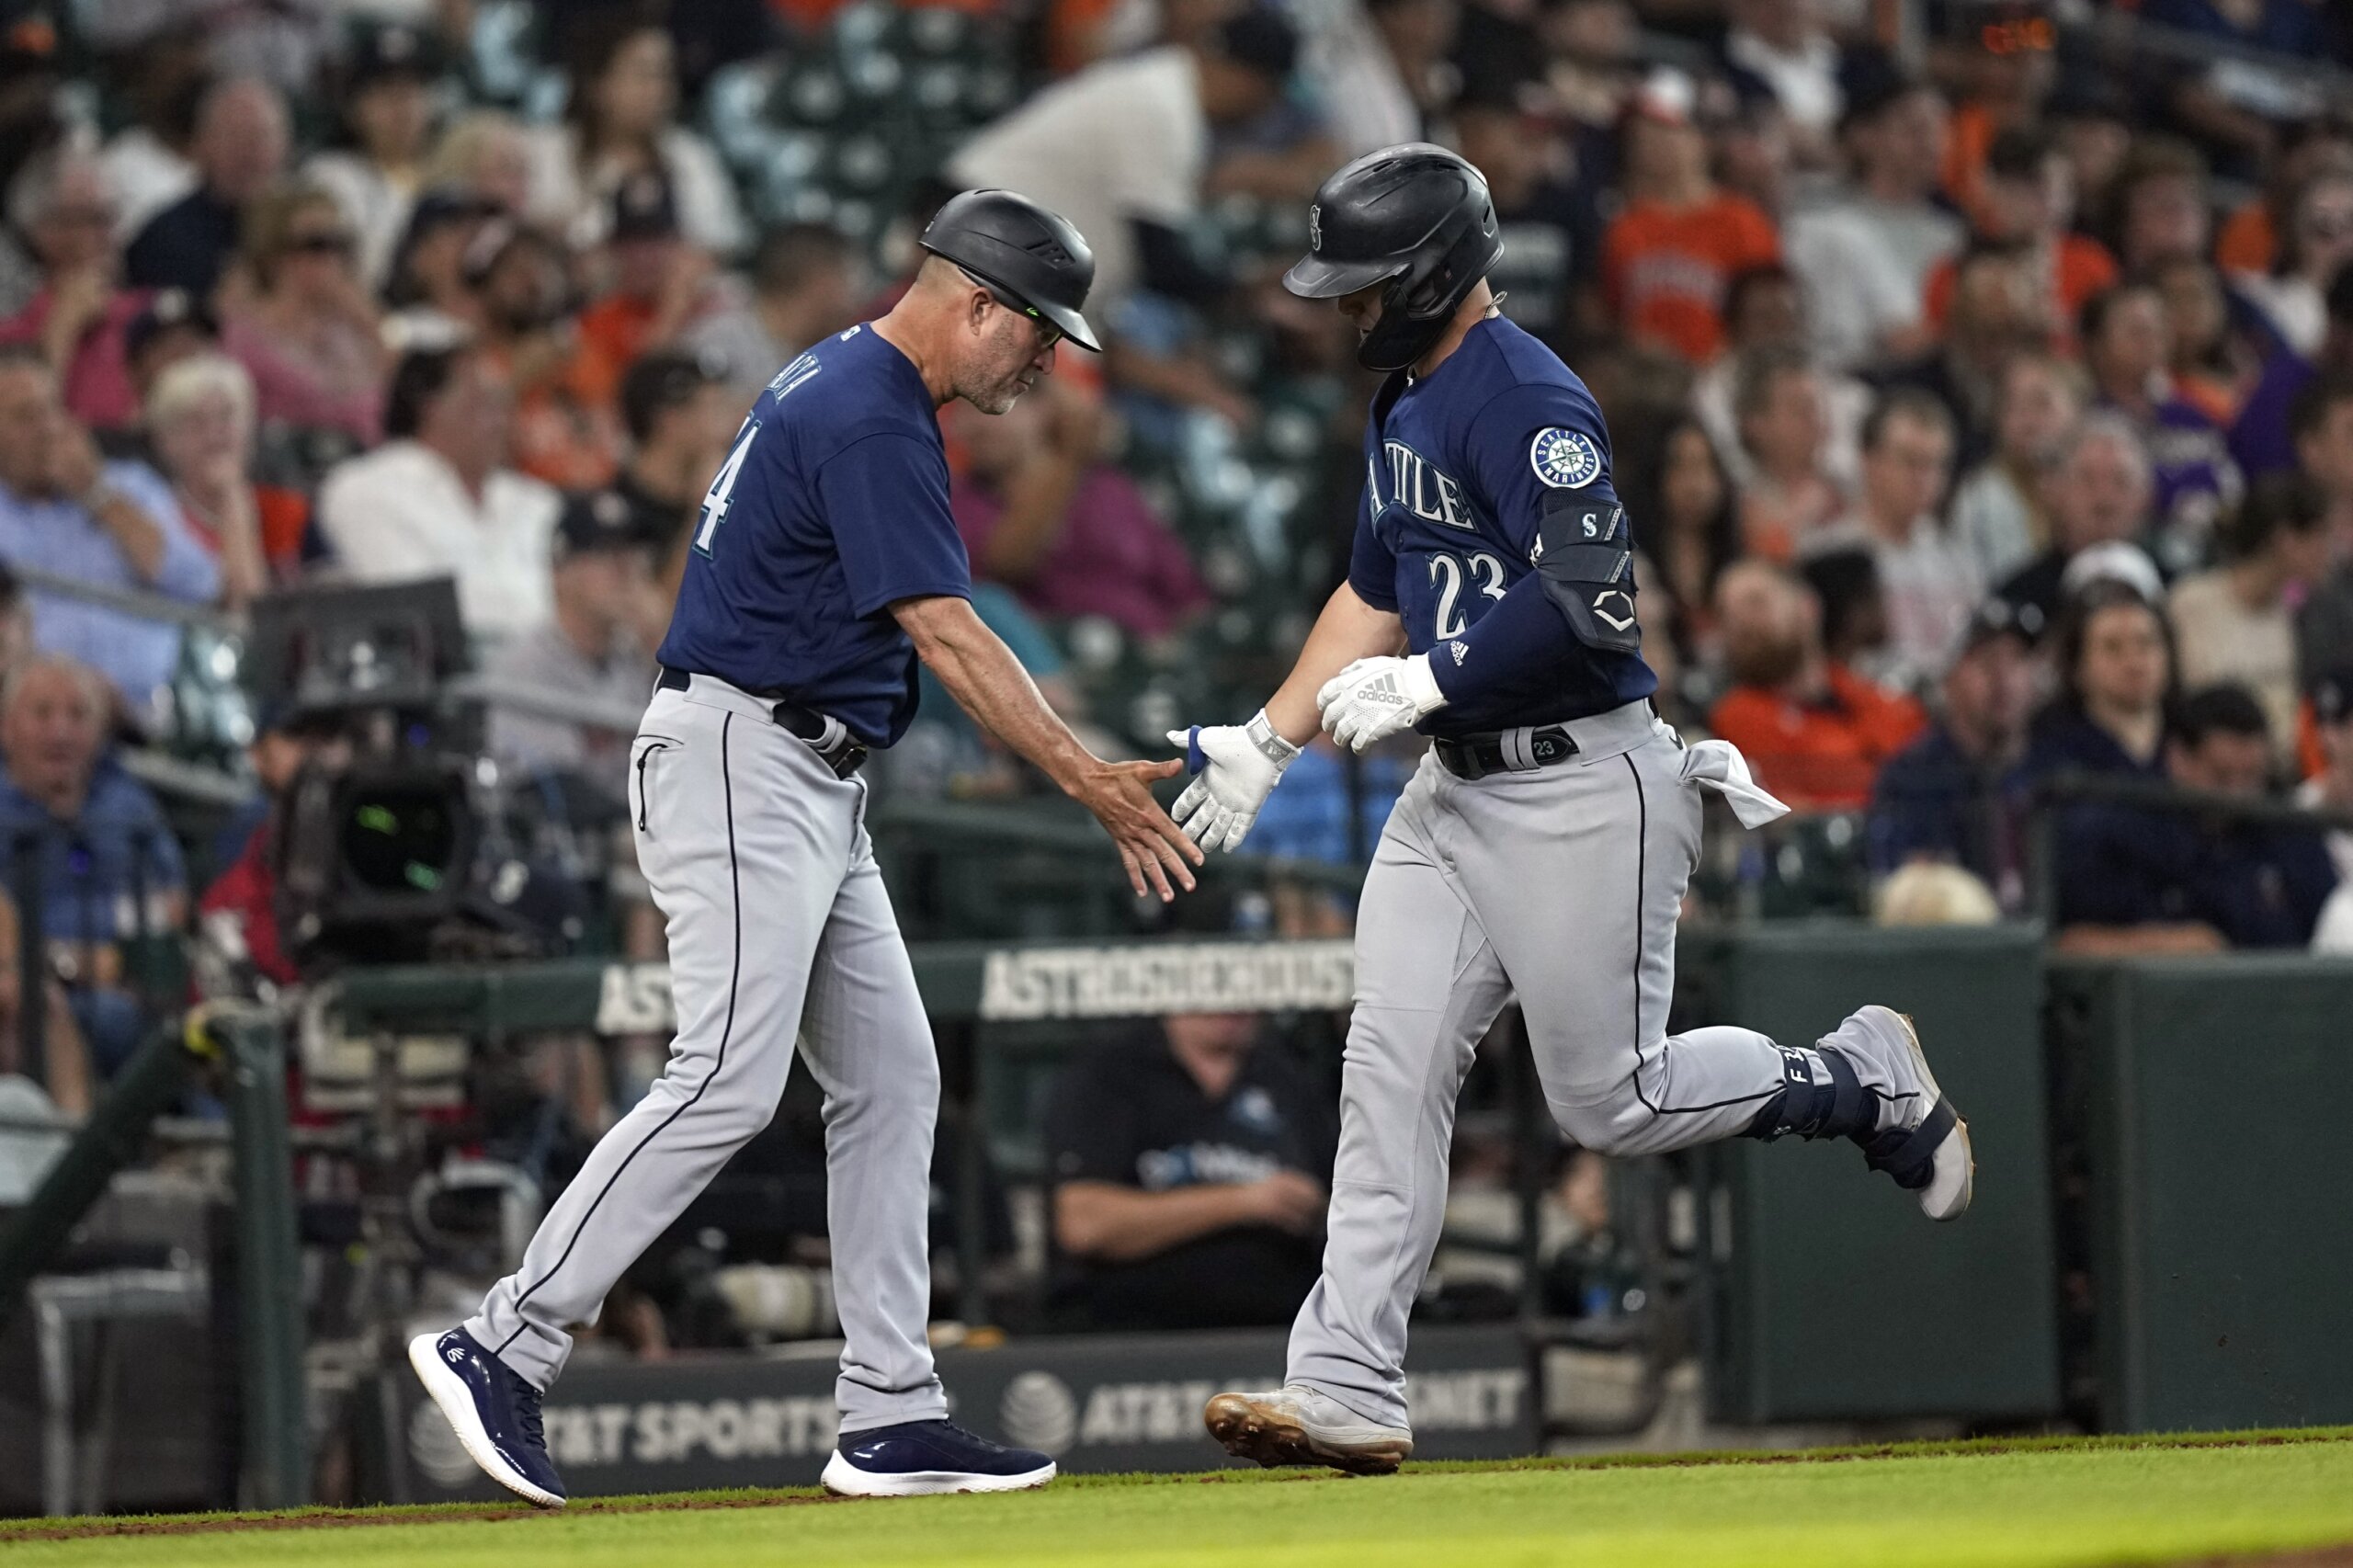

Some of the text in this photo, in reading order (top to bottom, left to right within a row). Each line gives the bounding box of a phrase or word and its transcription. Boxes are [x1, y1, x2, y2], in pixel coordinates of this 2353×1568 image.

[1537, 430, 1586, 456] SEATTLE
[1543, 456, 1595, 483] MARINERS
[1581, 513, 1597, 538] S
[1427, 551, 1507, 642] 23
[1449, 641, 1463, 666] adidas
[1357, 687, 1404, 706] adidas
[1532, 740, 1556, 756] 23
